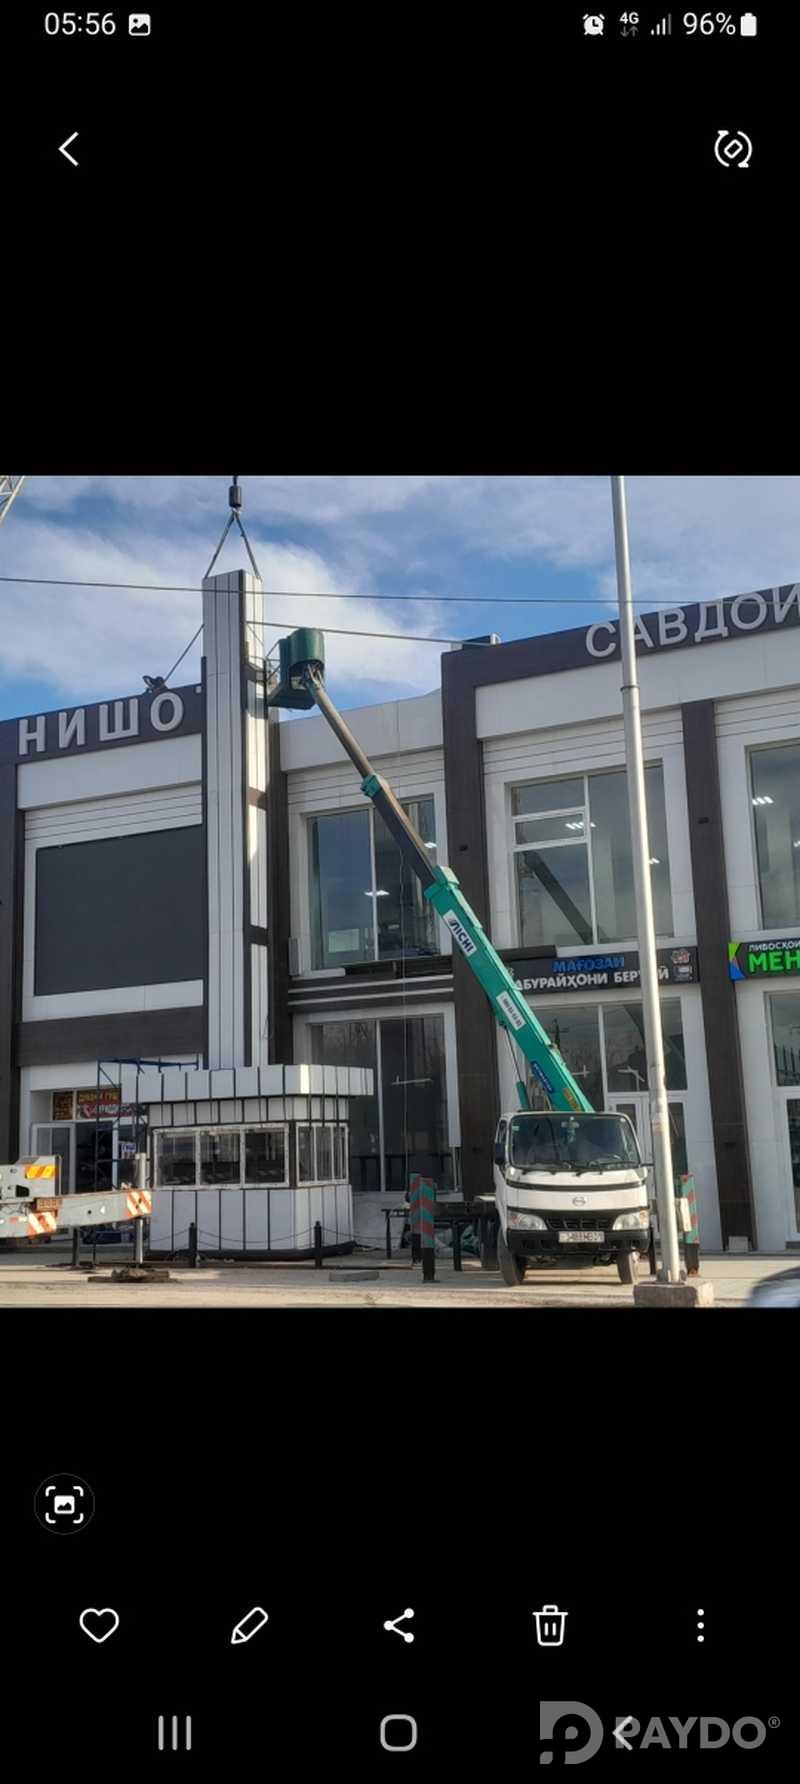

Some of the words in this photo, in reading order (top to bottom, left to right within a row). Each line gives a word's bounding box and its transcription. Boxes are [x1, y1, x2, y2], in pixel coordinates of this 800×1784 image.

[44, 12, 116, 37] 05:56
[619, 12, 639, 25] 4G
[683, 12, 736, 36] 96%
[18, 686, 202, 756] НИШО
[448, 917, 475, 954] AICHI
